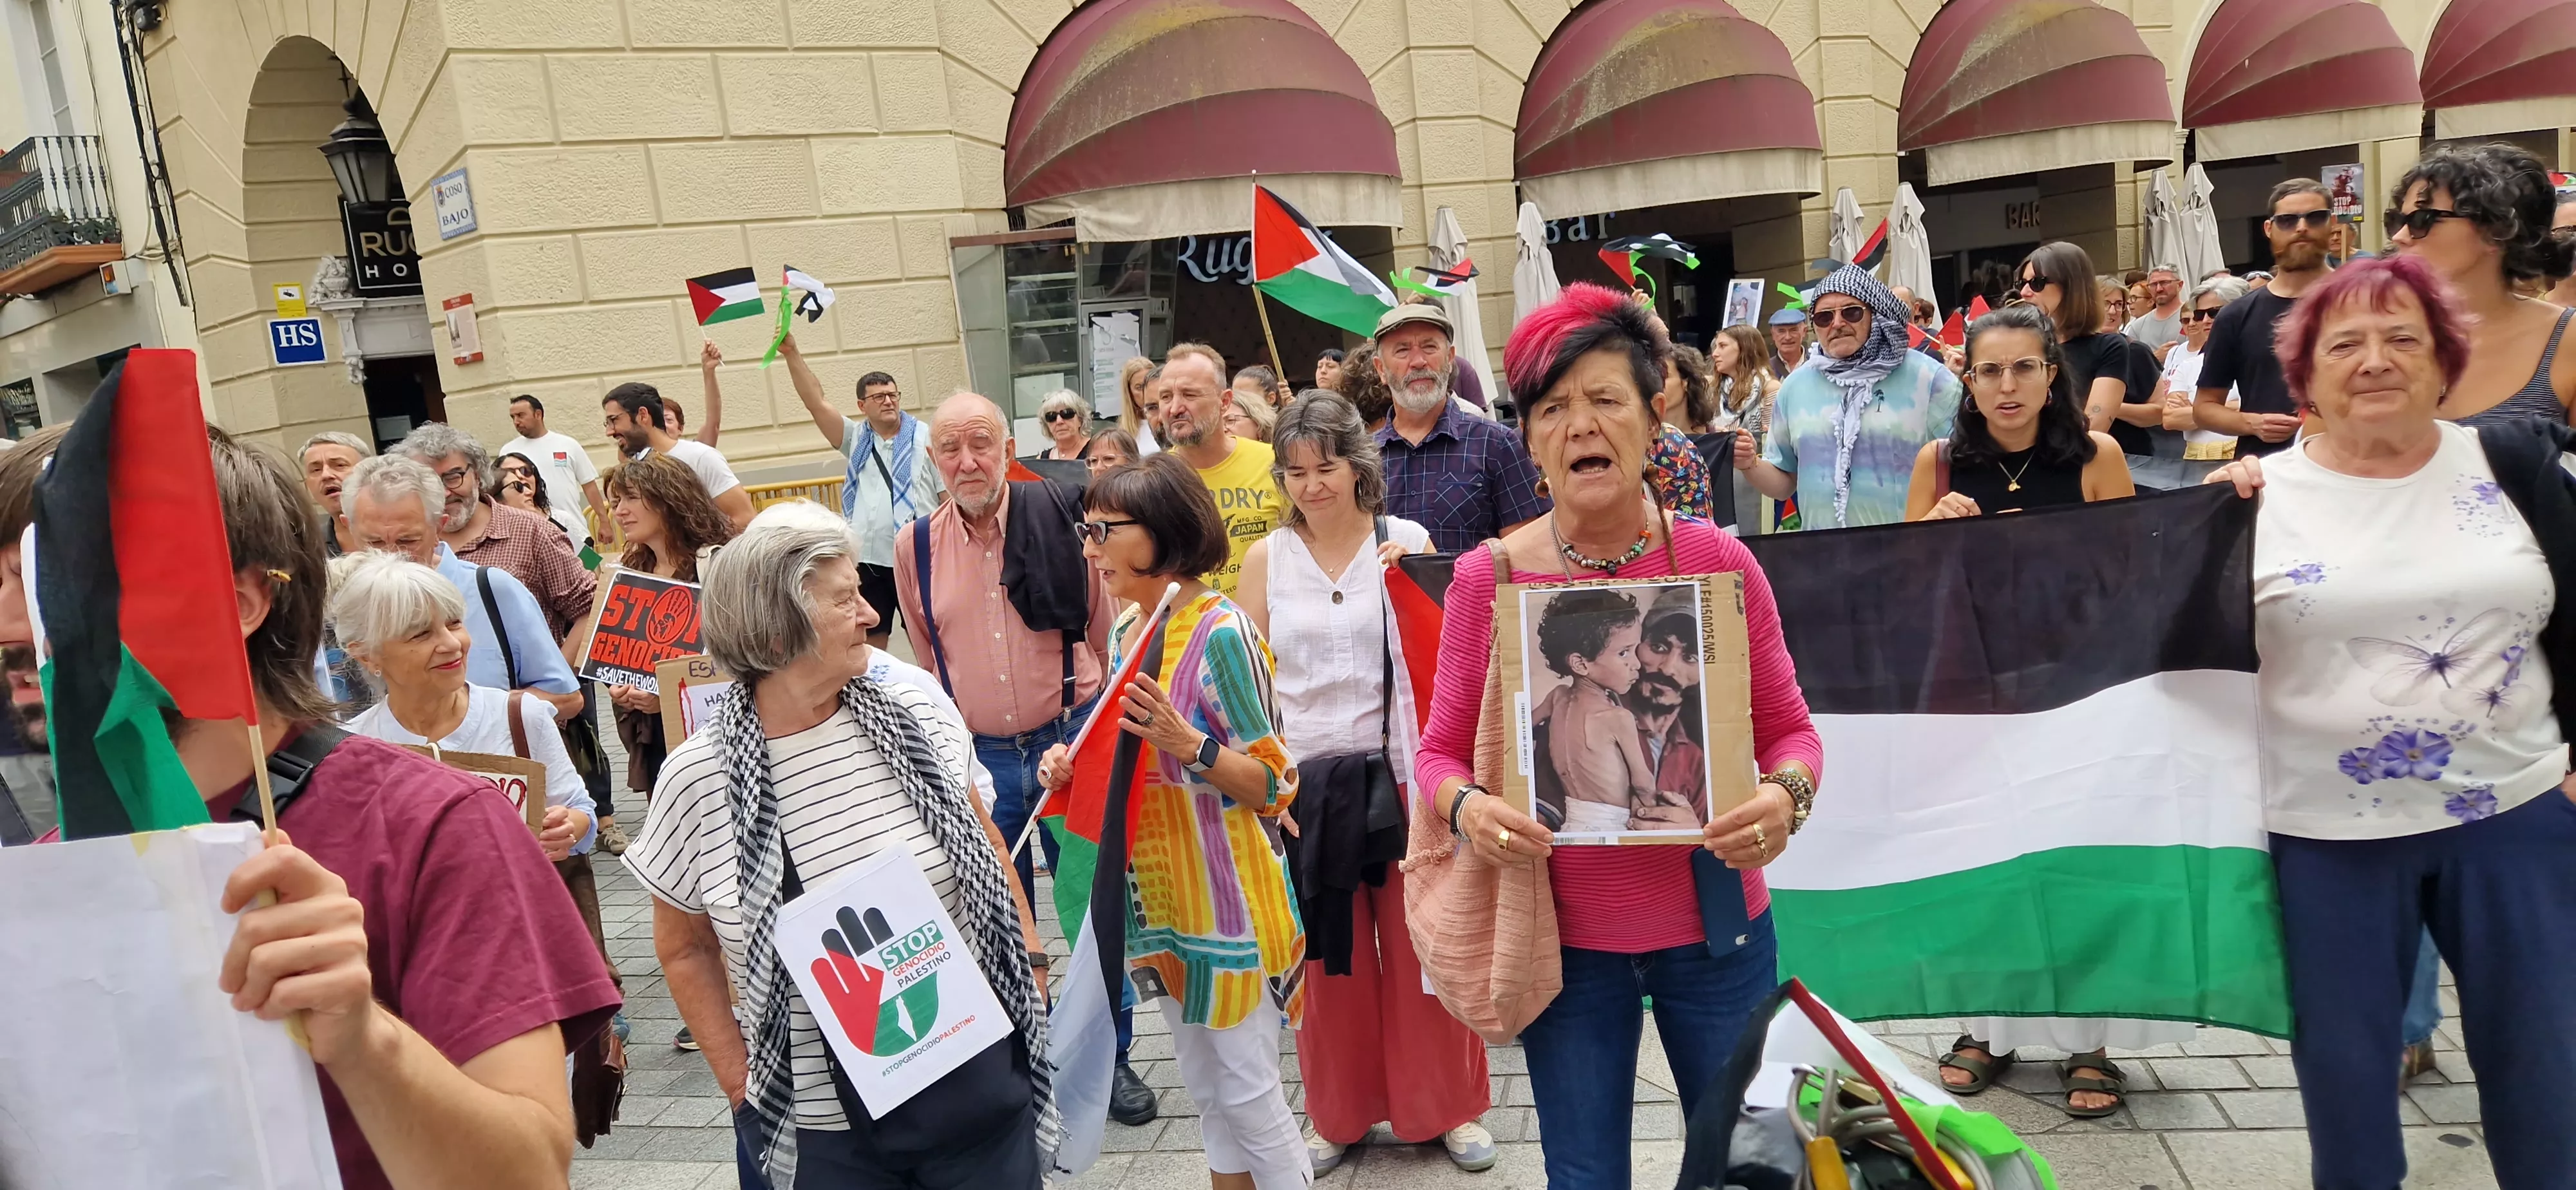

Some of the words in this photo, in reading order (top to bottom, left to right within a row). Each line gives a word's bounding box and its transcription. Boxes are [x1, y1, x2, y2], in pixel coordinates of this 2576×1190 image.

[444, 182, 462, 198] COSO
[2333, 196, 2352, 206] STOP
[442, 208, 469, 226] BAJO
[2333, 204, 2362, 216] NOCIDIO
[1545, 211, 1616, 244] Bar
[1178, 234, 1253, 286] Rug
[365, 263, 408, 279] HO
[275, 323, 317, 348] HS
[1235, 522, 1264, 535] JAPAN
[1240, 534, 1264, 543] QUALITY
[1221, 585, 1237, 595] TEED
[704, 690, 728, 707] HA
[882, 922, 938, 969] STOP
[892, 941, 945, 977] GENOCIDIO
[896, 951, 951, 988] PALESTINO
[882, 1015, 976, 1077] #STOPGENOCIDIOPALESTINO
